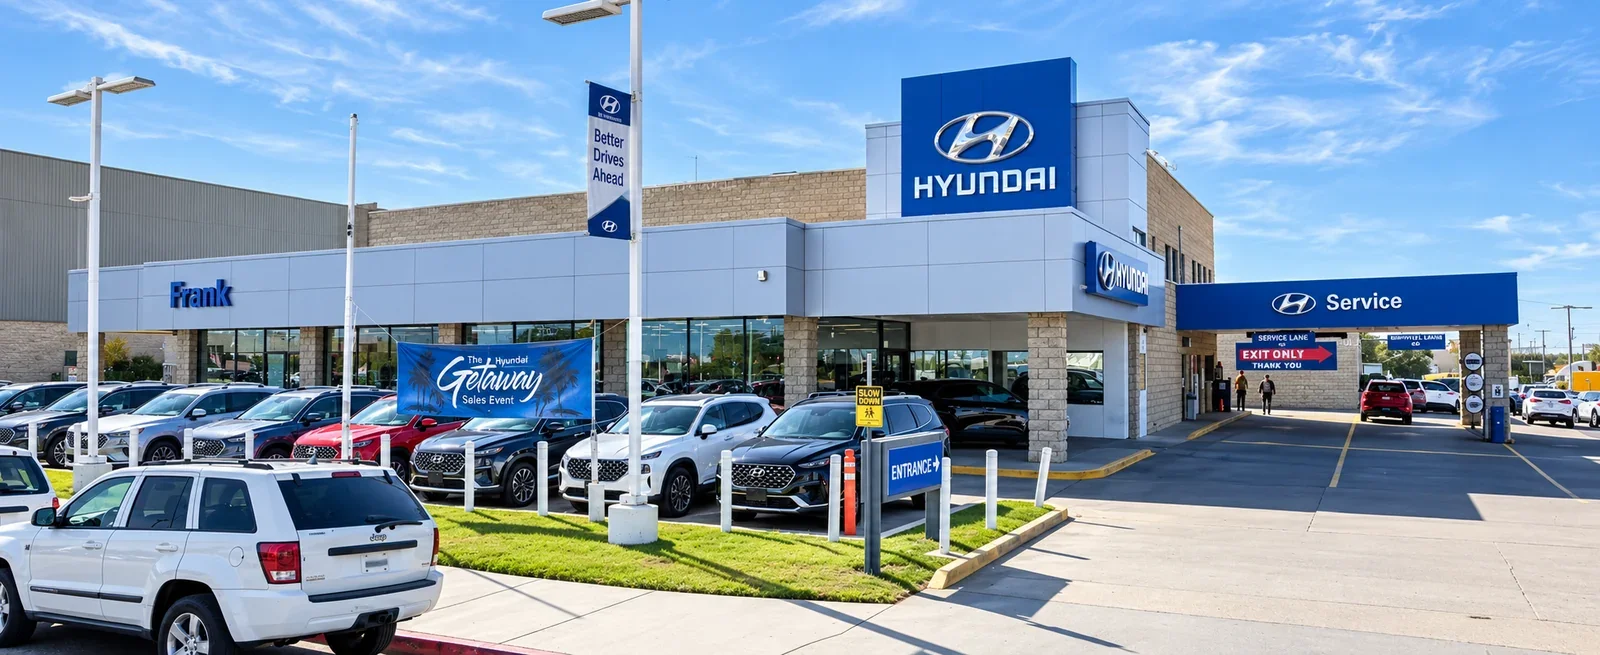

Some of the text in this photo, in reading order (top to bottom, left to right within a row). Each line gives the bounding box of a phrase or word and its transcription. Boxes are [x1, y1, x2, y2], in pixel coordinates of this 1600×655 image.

[594, 128, 624, 148] Better
[593, 147, 624, 168] Drives
[593, 167, 624, 187] Ahead
[914, 166, 1056, 199] HYUNDAI
[1116, 260, 1149, 296] HYUNDAI
[170, 278, 232, 308] Frank
[1326, 292, 1403, 311] Service
[1258, 334, 1287, 342] SERVICE
[467, 355, 529, 367] The Hyundai
[1242, 349, 1304, 359] EXIT ONLY
[436, 355, 543, 409] Getaway
[462, 394, 515, 405] Sales Event
[859, 389, 880, 397] SLOW
[859, 397, 880, 405] DOWN
[891, 458, 932, 481] ENTRANCE
